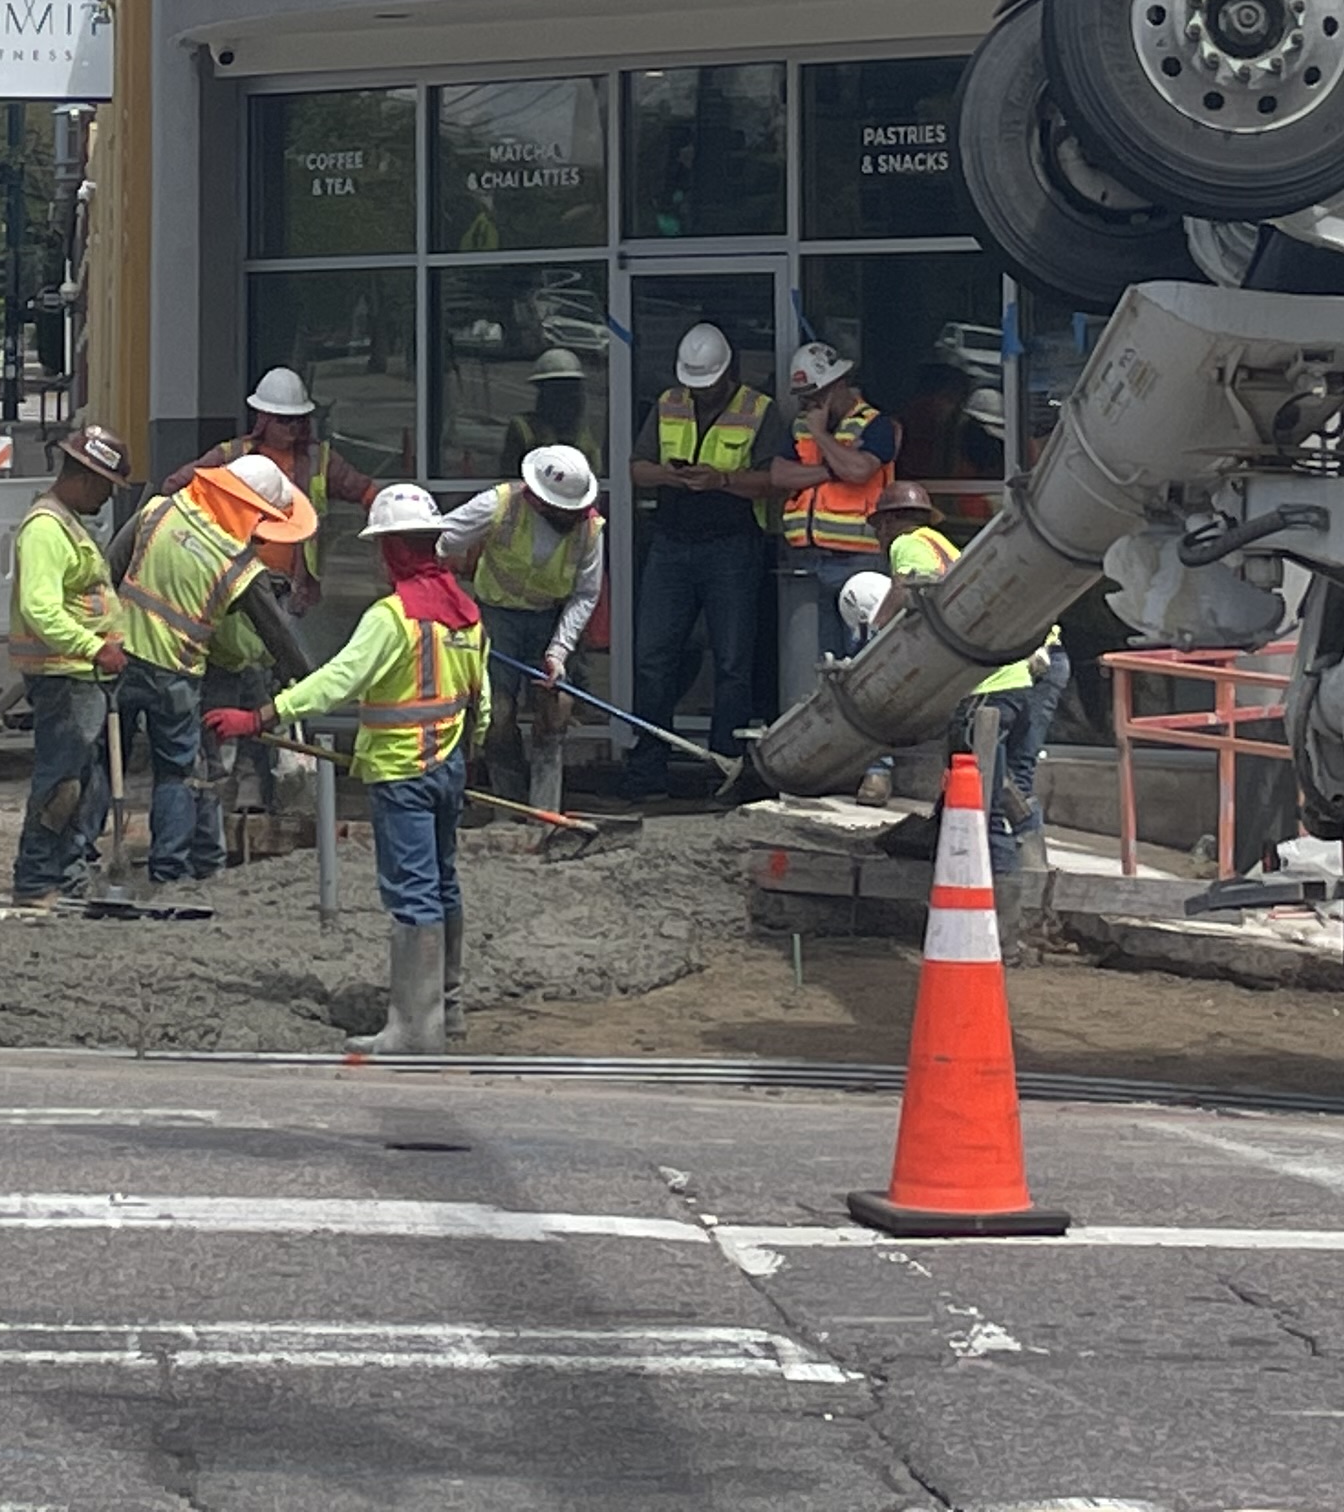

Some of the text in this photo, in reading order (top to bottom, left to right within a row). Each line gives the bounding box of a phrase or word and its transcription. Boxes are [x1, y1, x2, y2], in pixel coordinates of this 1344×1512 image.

[863, 124, 946, 146] PASTRIES
[307, 151, 363, 170] COFFEE
[490, 143, 565, 163] MATCHA
[861, 151, 949, 174] & SNACKS
[312, 177, 356, 196] & TEA
[467, 167, 580, 191] & CHAI LATTES
